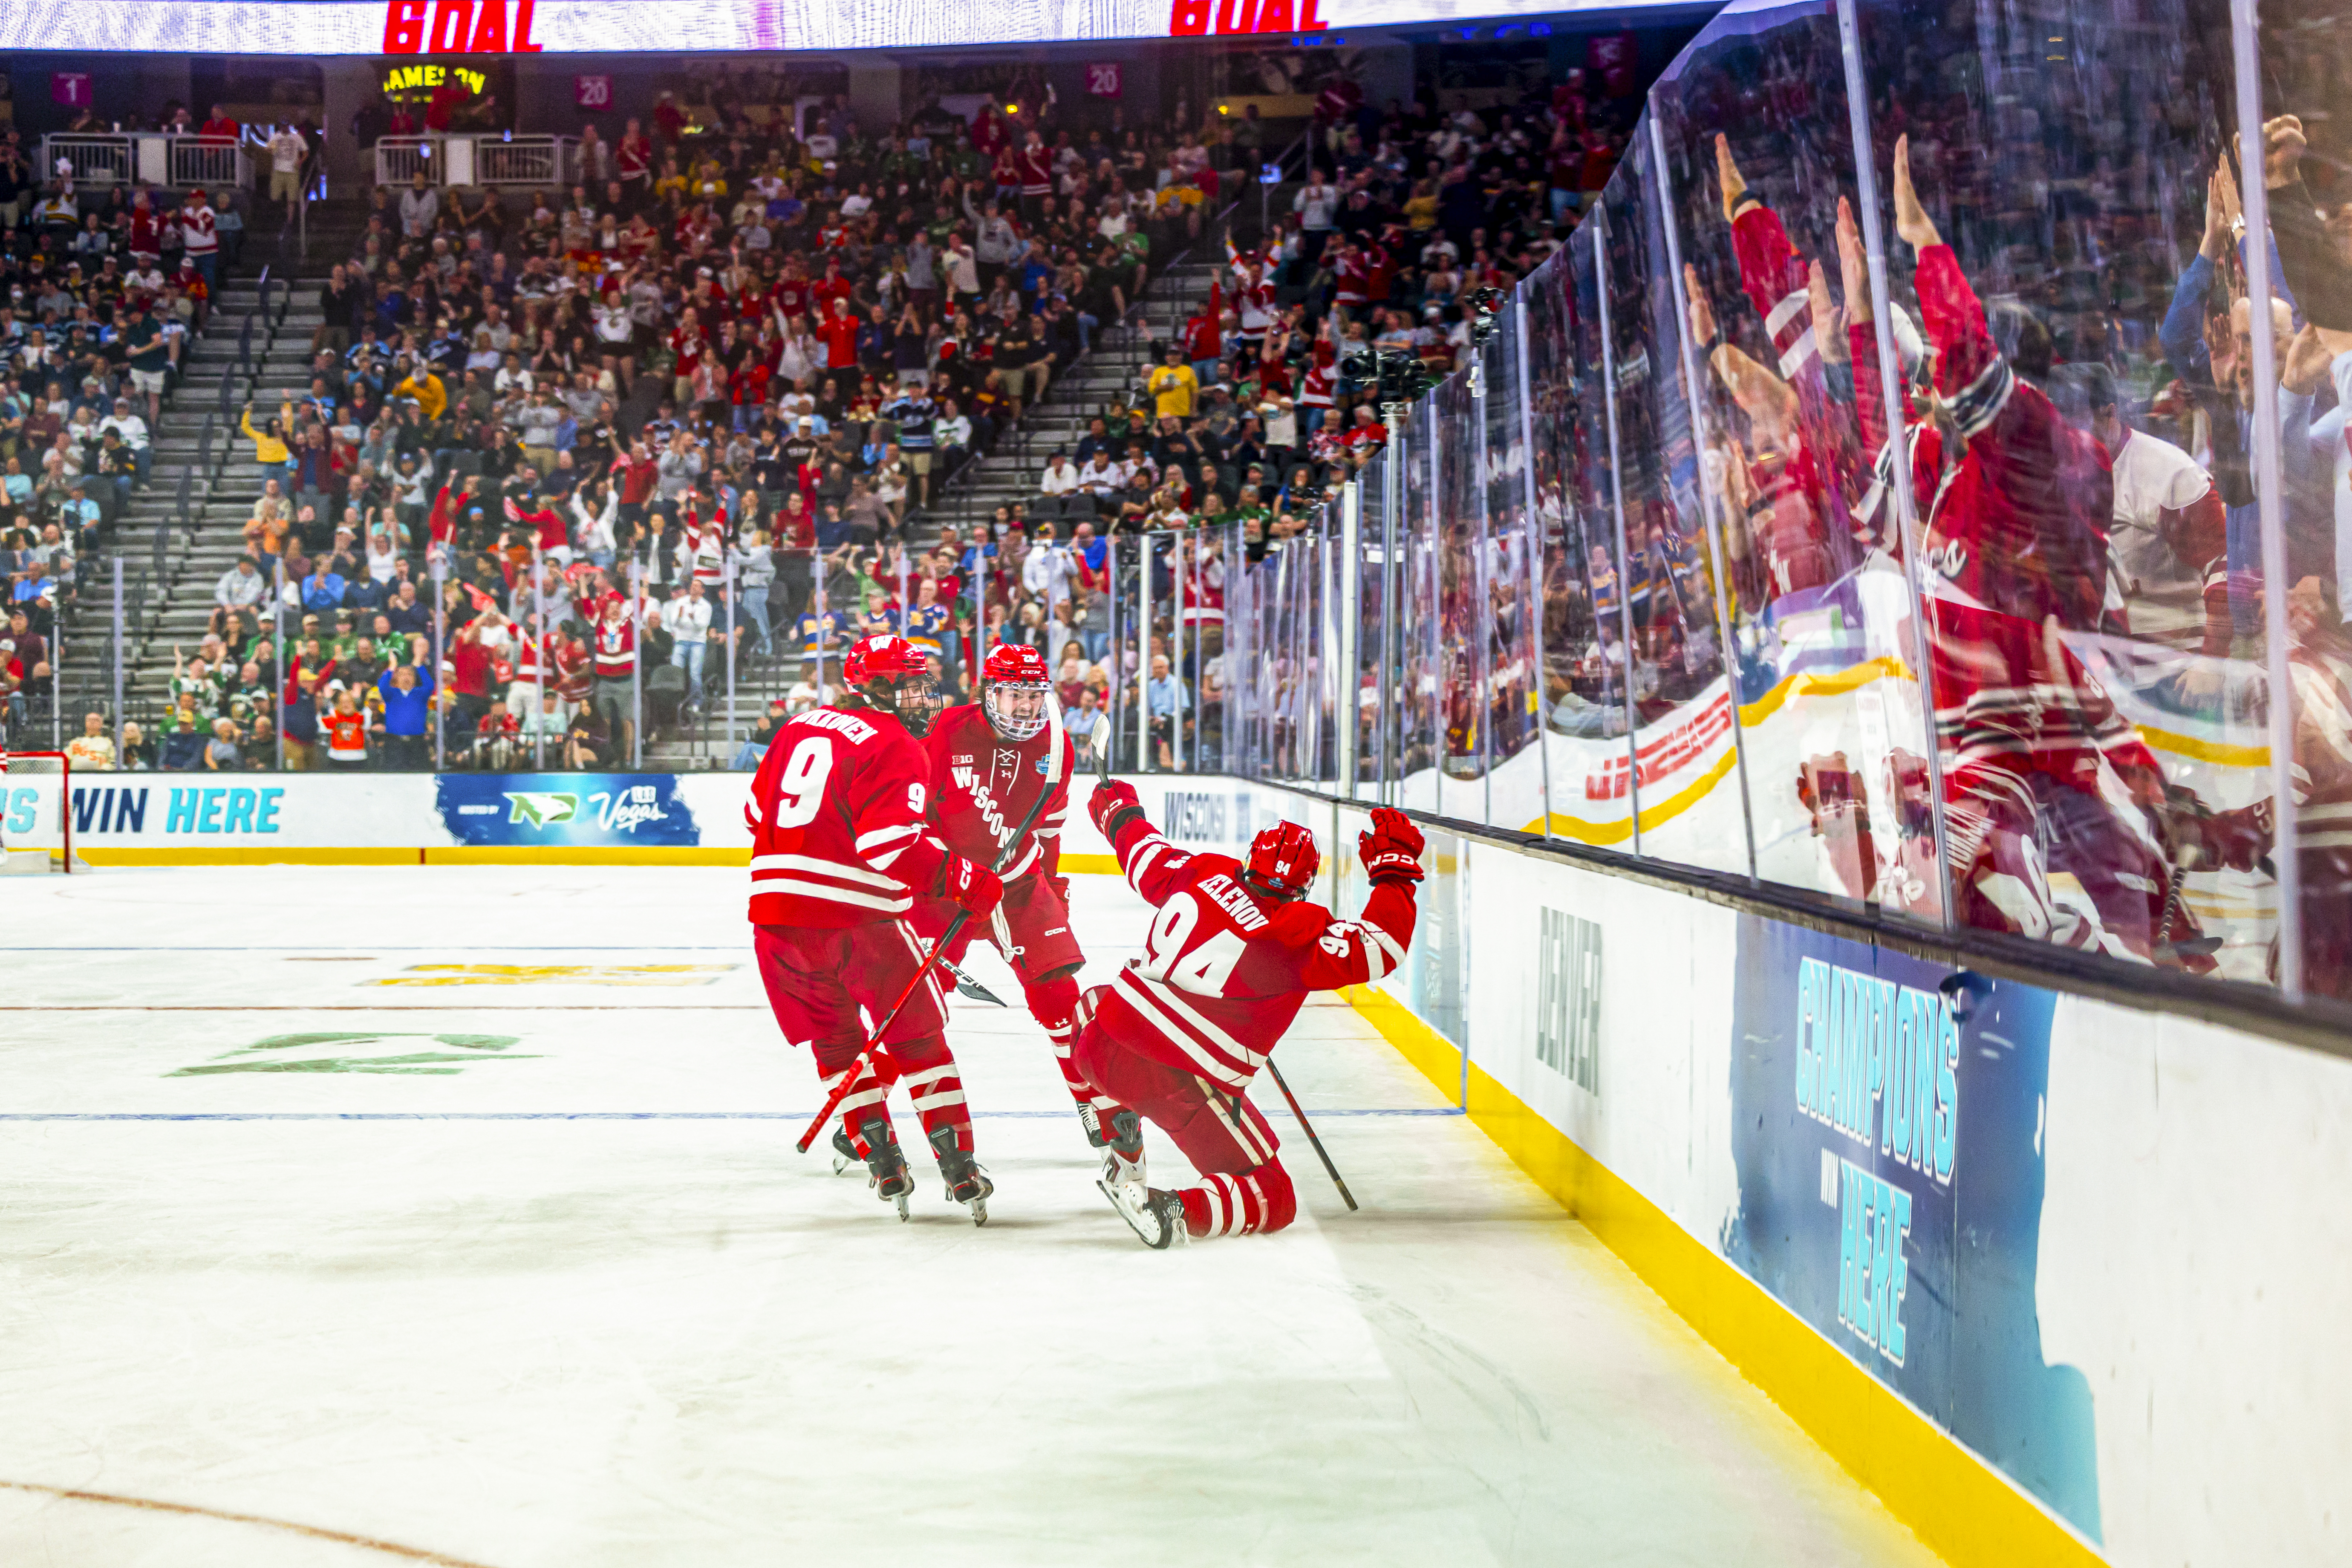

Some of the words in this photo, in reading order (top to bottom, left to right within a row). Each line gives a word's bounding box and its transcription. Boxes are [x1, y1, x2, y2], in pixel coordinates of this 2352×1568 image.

[384, 0, 543, 54] GOAL
[1169, 0, 1329, 36] GOAL
[66, 79, 77, 101] 1
[869, 635, 894, 653] W
[777, 736, 833, 828] 9
[908, 782, 925, 813] 9
[58, 788, 148, 832] WIN
[166, 788, 284, 833] HERE
[588, 789, 669, 833] Vegas
[951, 766, 1016, 863] WISCON
[1275, 860, 1291, 876] 94
[1368, 853, 1415, 872] CCM
[1197, 874, 1270, 932] ZELENOV
[1134, 892, 1247, 999] 94
[1319, 921, 1358, 958] 94
[1795, 956, 1960, 1187] CHAMPIONS
[1821, 1147, 1839, 1210] WIN
[1838, 1158, 1912, 1369] HERE
